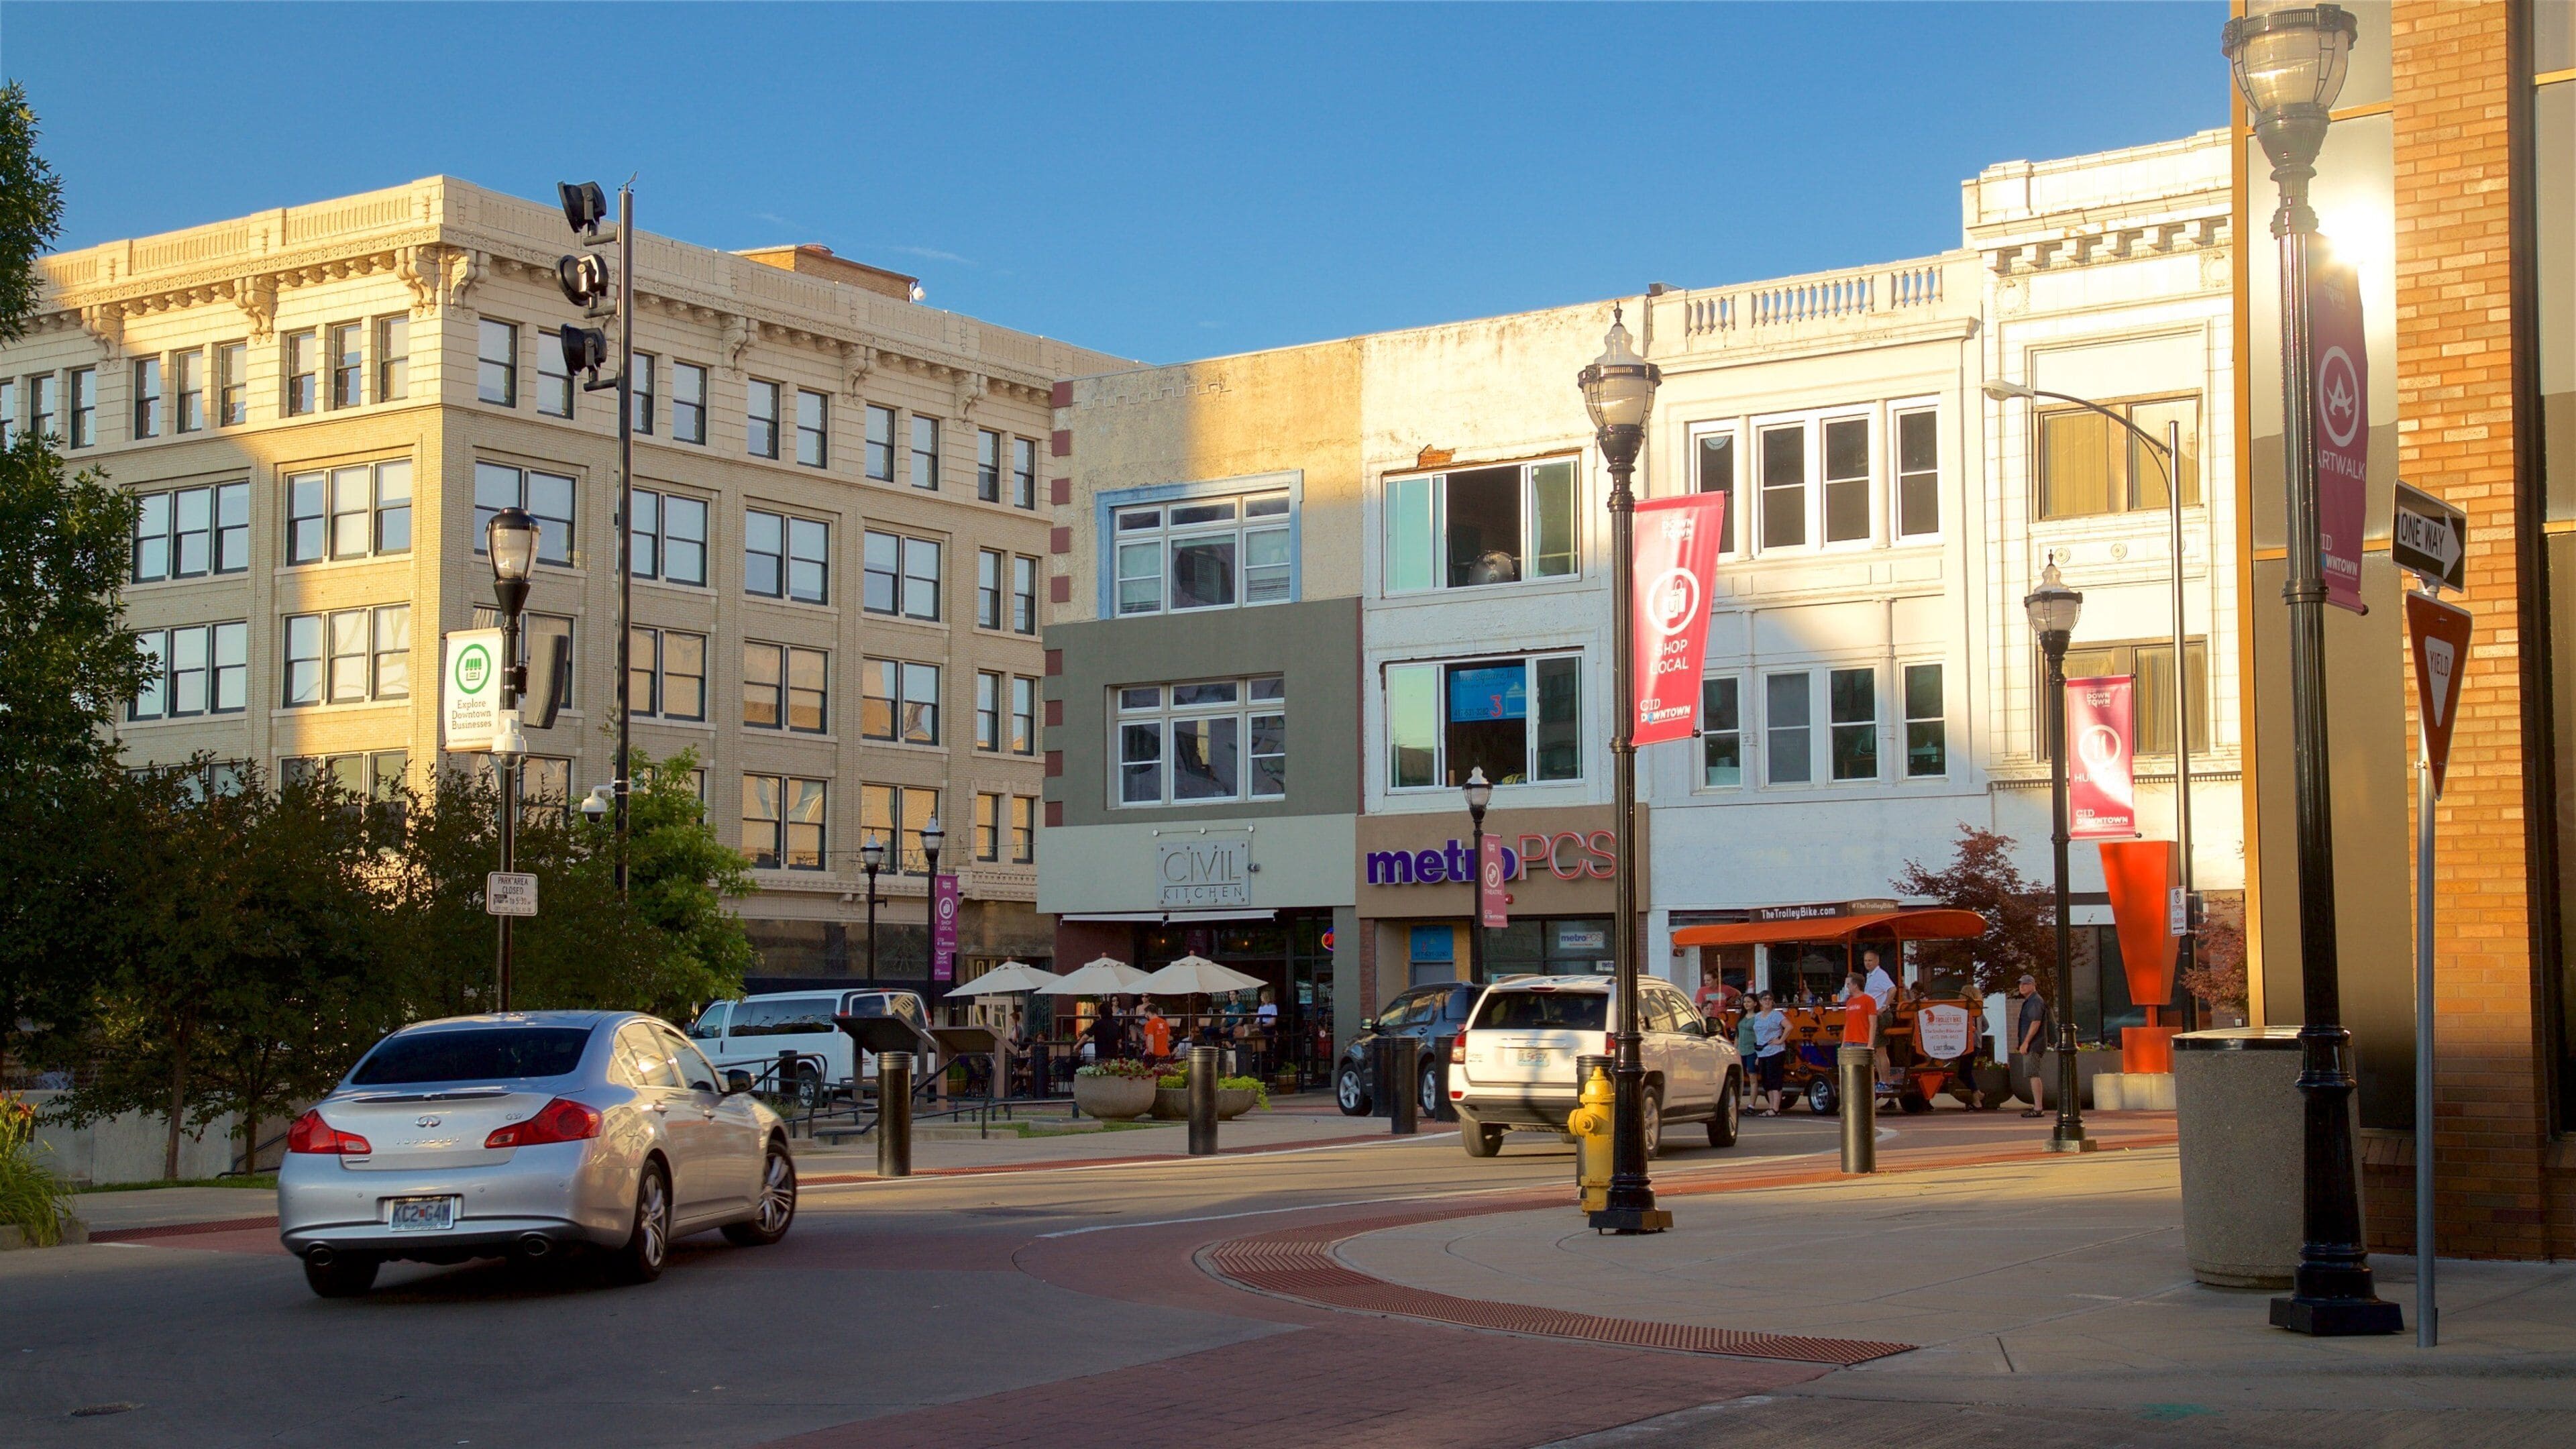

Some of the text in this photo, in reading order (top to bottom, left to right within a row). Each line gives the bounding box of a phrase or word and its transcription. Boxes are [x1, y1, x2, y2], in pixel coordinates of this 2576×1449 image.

[2401, 512, 2445, 557] ONE WAY
[2321, 533, 2332, 551] ID
[1654, 639, 1688, 657] SHOP
[1650, 657, 1689, 676] LOCAL
[2429, 649, 2449, 677] YIELD
[458, 698, 486, 710] Explore
[1490, 694, 1502, 718] 3
[1640, 698, 1661, 712] CID
[2086, 698, 2111, 708] TOWN
[452, 710, 492, 720] Downtown
[452, 720, 492, 730] Businesses
[2076, 809, 2094, 817] CID
[1164, 851, 1241, 881] CIVIL
[498, 876, 529, 885] PARK AREA
[502, 886, 524, 895] CLOSED
[1164, 887, 1242, 899] KITCHEN
[1761, 906, 1835, 920] TheTrolleyBike.com
[1561, 933, 1602, 942] metroPCS
[505, 1112, 524, 1120] G37
[393, 1204, 419, 1223] KC2
